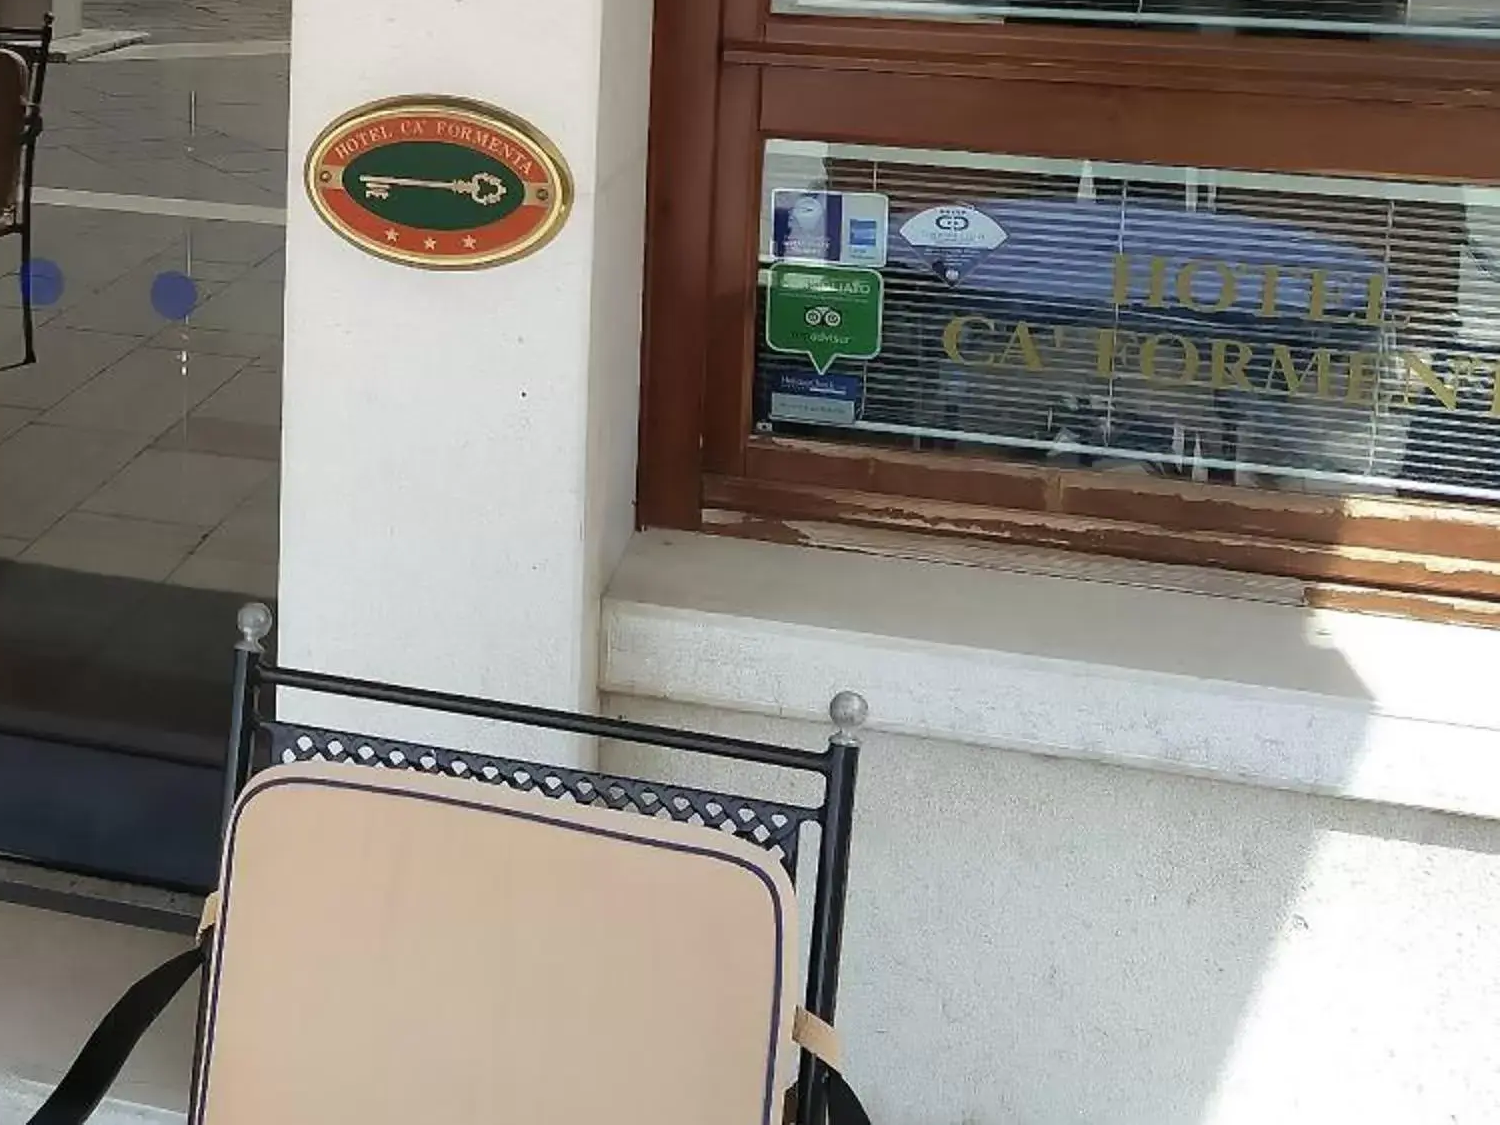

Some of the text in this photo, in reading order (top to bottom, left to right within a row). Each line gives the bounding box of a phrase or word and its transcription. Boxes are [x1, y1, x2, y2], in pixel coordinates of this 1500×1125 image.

[334, 125, 394, 161] HOTEL
[436, 120, 534, 176] FORMENTA
[1112, 253, 1410, 328] HOTEL
